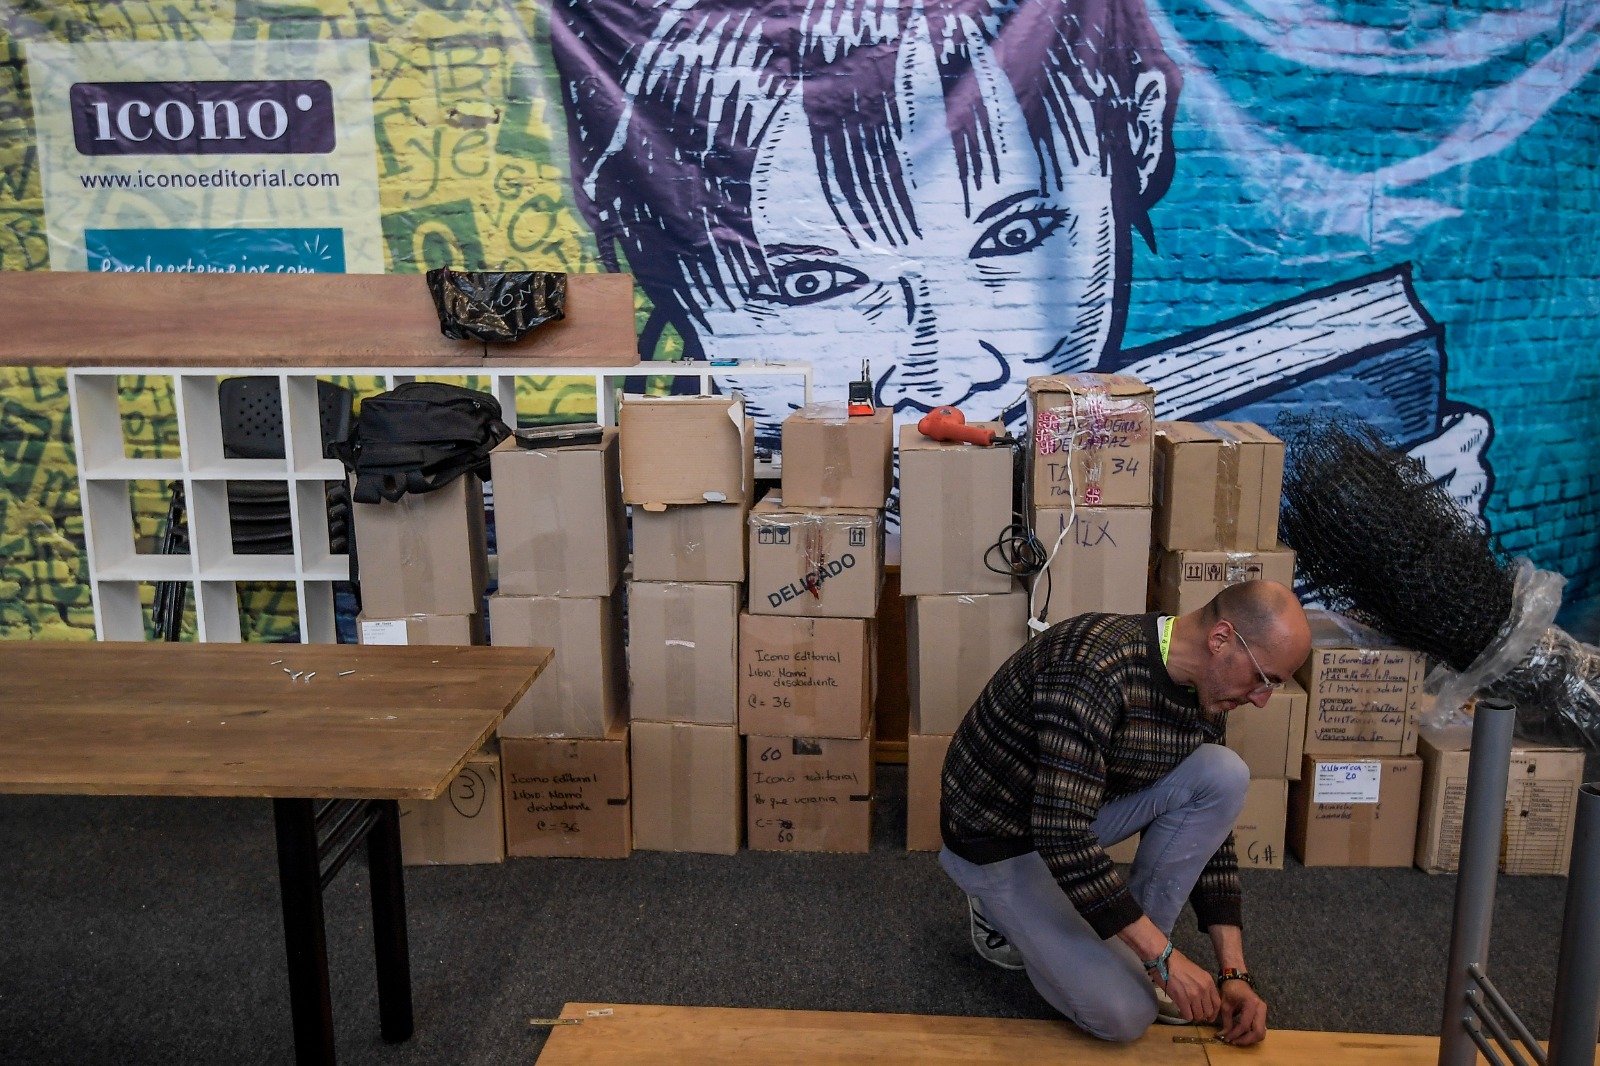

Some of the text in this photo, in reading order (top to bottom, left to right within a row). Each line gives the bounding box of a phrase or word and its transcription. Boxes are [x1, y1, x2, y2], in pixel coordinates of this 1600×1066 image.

[91, 99, 289, 142] icono
[80, 169, 340, 188] www.iconoeditorial.com
[101, 255, 315, 273] Paraleertemejorcom
[466, 284, 531, 312] AVON
[1112, 457, 1139, 477] 34
[1059, 513, 1117, 548] MIX
[767, 553, 856, 608] DELICADO
[755, 649, 841, 663] Icono Editorial
[772, 696, 791, 708] 36
[760, 747, 782, 761] 60
[1345, 771, 1357, 780] 20
[777, 829, 794, 843] 60
